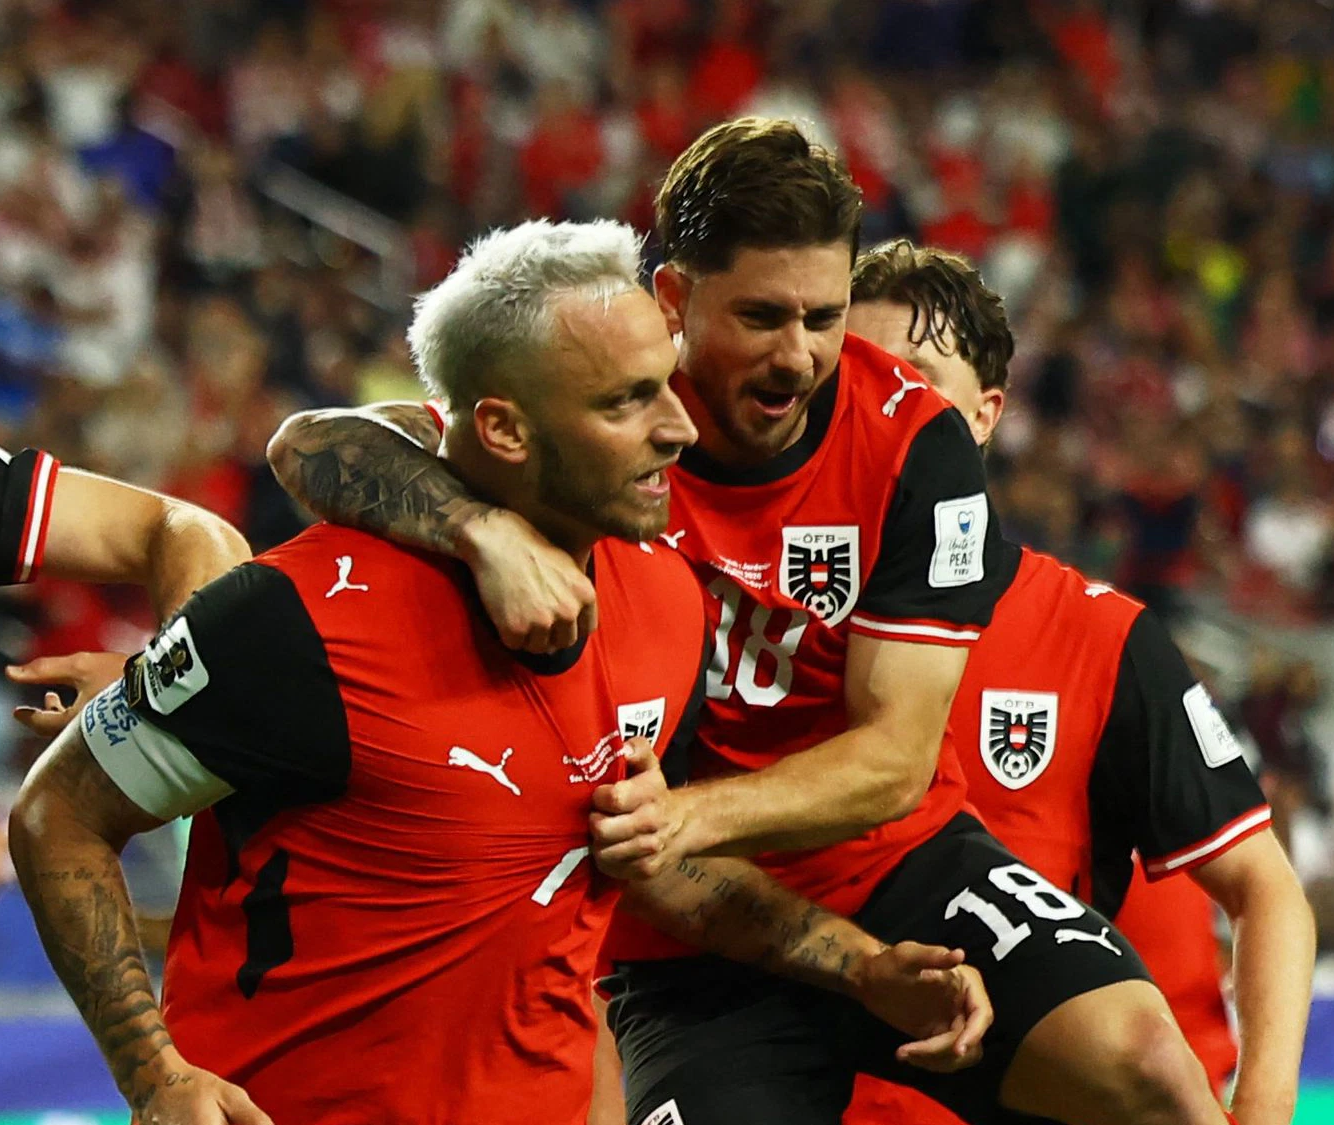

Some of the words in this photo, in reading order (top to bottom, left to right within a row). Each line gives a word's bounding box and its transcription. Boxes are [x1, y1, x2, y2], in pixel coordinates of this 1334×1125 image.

[803, 533, 835, 543] ÖFB
[706, 576, 809, 708] 18
[945, 863, 1087, 961] 18
